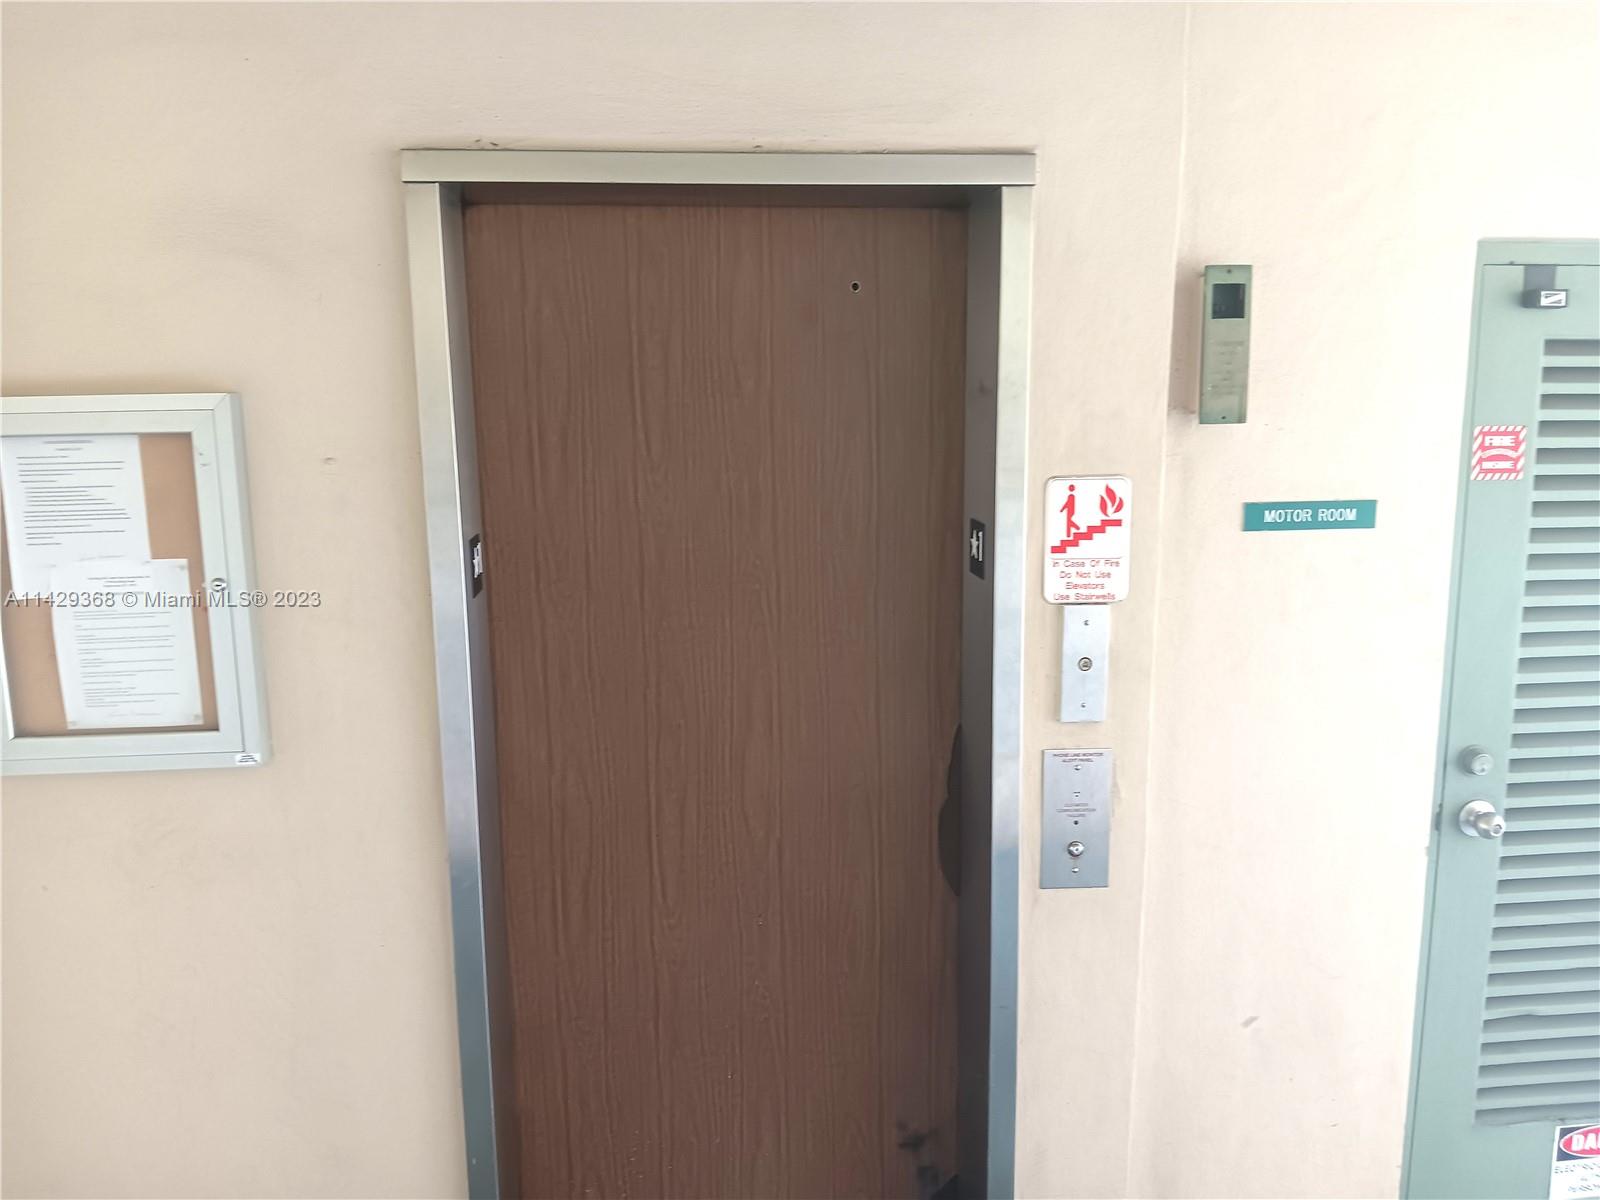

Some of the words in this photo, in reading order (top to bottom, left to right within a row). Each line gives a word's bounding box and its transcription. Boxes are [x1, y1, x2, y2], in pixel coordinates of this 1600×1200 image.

[1263, 508, 1312, 523] MOTOR
[1317, 508, 1357, 522] ROOM
[1063, 559, 1086, 568] Case
[1090, 559, 1101, 568] Of
[1104, 559, 1120, 568] Fire
[1059, 570, 1072, 579] Do
[1075, 570, 1091, 579] Not
[1095, 570, 1112, 579] Use
[1065, 581, 1105, 590] Elevators
[1053, 592, 1071, 601] Use
[1074, 592, 1116, 601] Stairwells
[1571, 1132, 1600, 1152] DA
